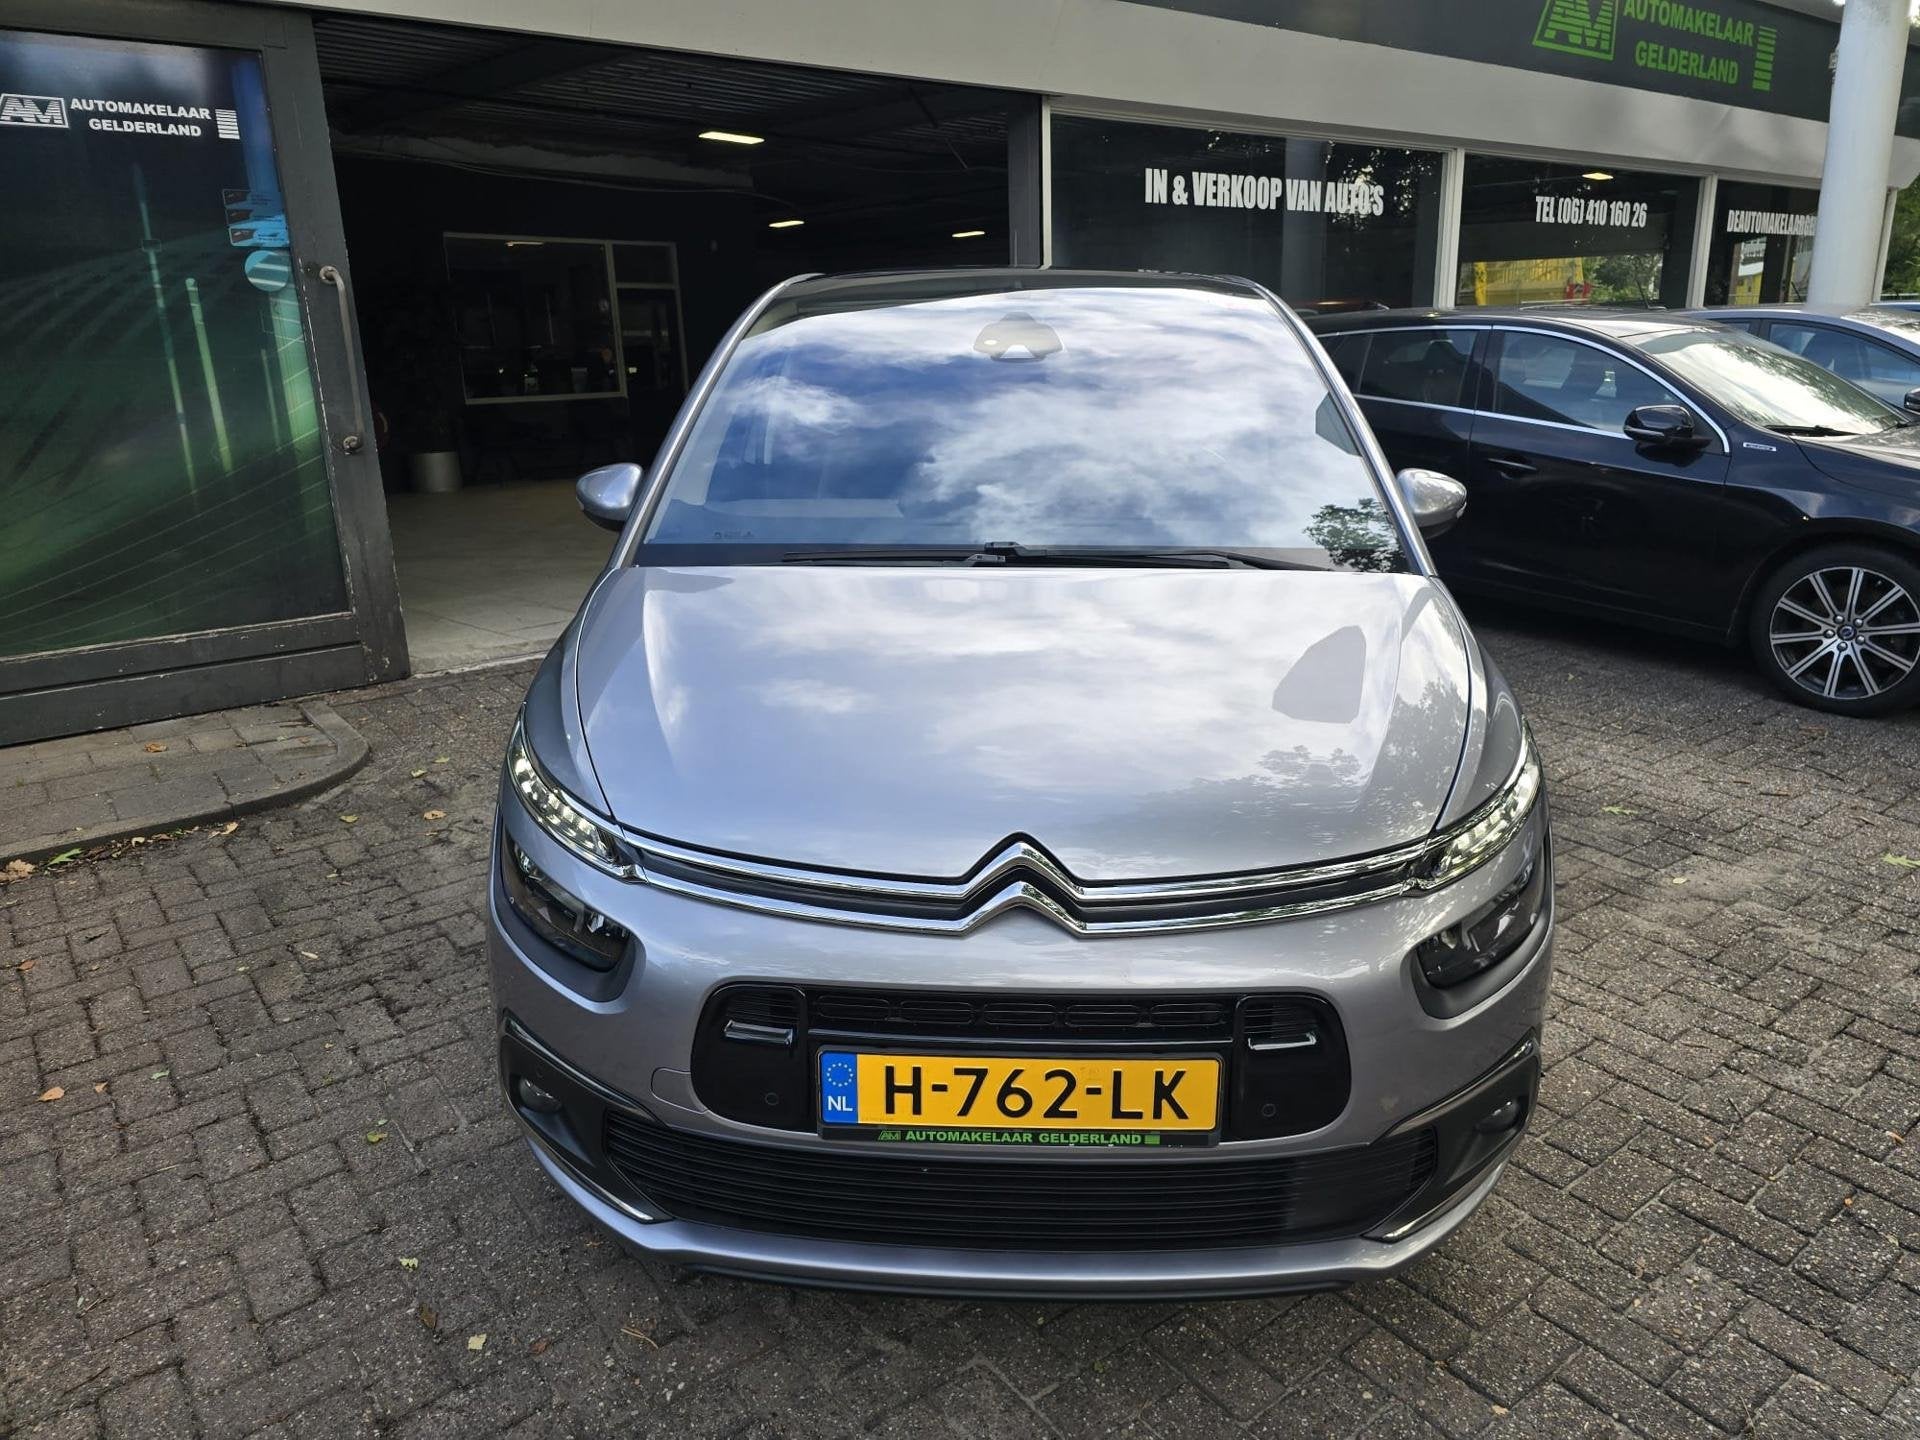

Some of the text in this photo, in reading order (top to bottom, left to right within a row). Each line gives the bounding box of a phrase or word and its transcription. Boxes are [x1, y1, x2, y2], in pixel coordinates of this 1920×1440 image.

[1623, 0, 1754, 46] AUTOMAKELAAR
[1635, 41, 1738, 84] GELDERLAND
[70, 98, 211, 120] AUTOMAKELAAR
[88, 118, 202, 137] GELDERLAND
[1145, 168, 1384, 216] IN & VERKOOP VAN AUTO'S
[1535, 196, 1648, 228] TEL (06) 410 160 26
[828, 1095, 853, 1112] NL
[884, 1065, 1189, 1120] H-762-LK
[905, 1130, 1033, 1143] AUTOMAKELAAR
[1038, 1132, 1141, 1145] GELDERLAND
